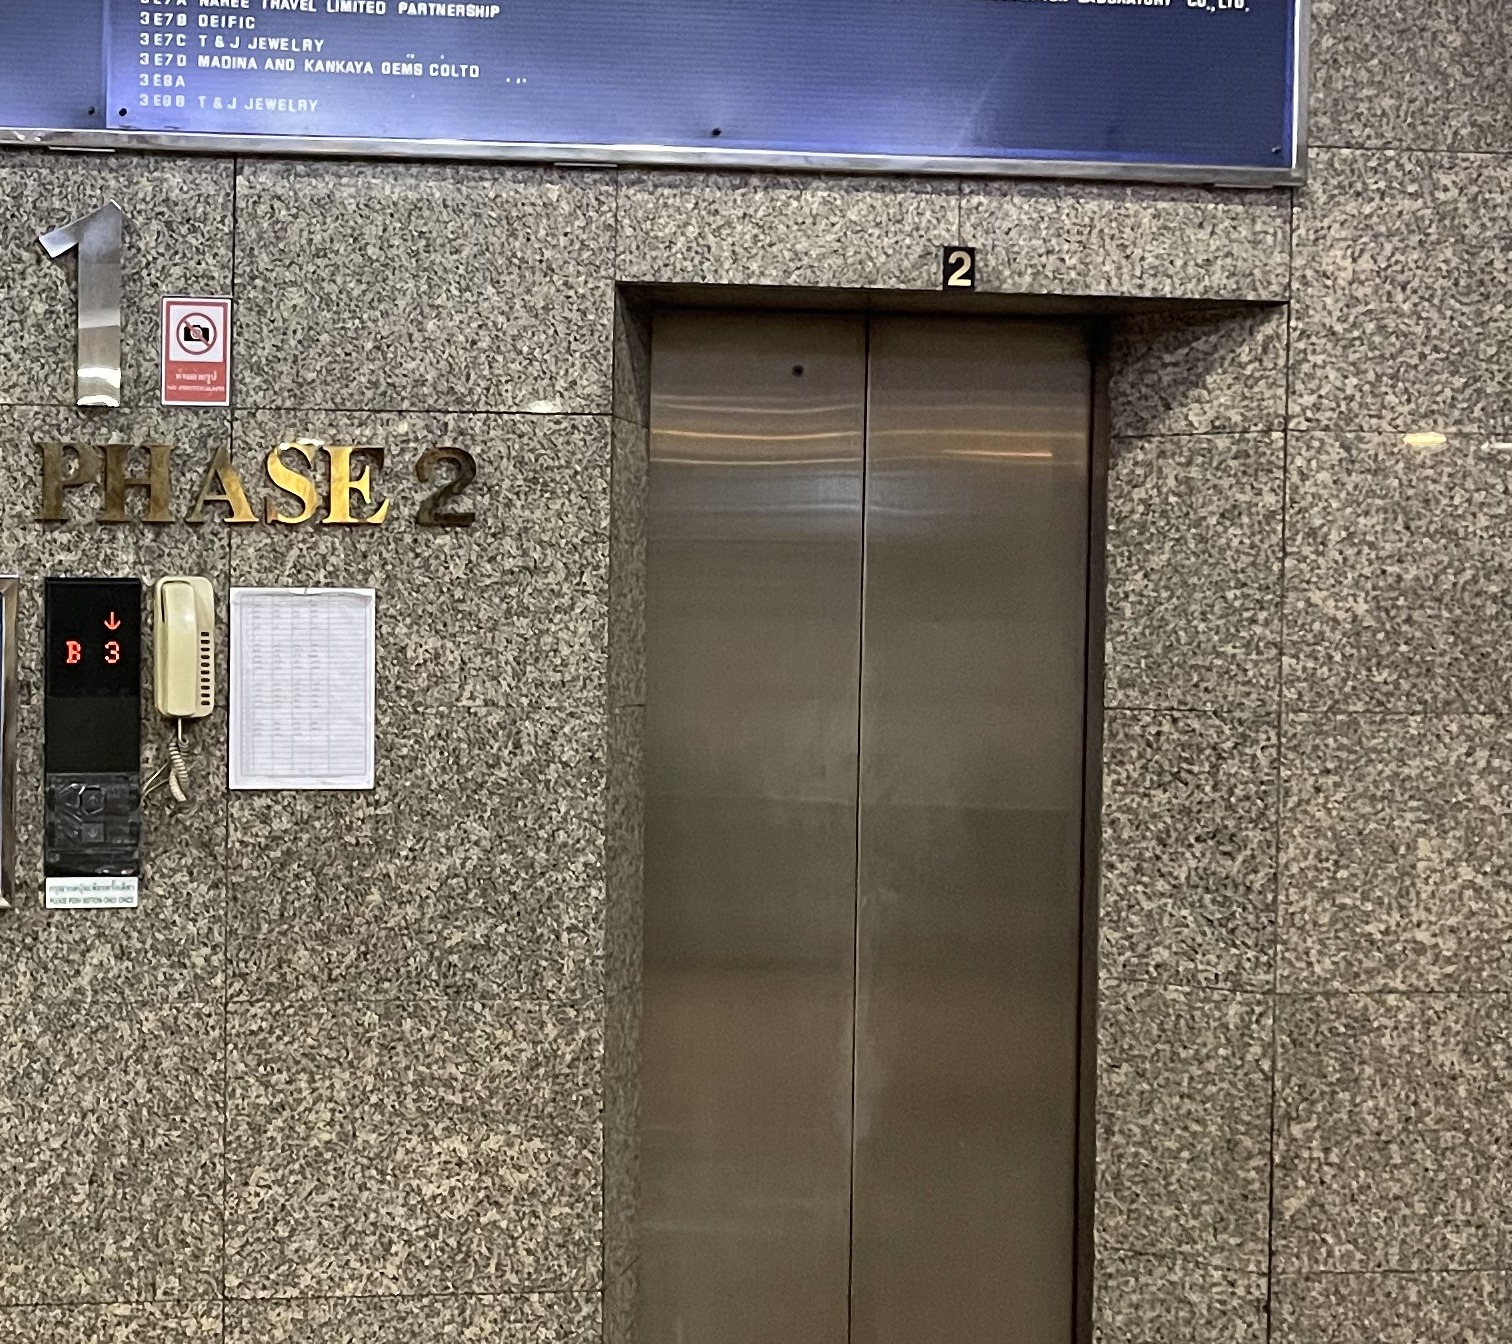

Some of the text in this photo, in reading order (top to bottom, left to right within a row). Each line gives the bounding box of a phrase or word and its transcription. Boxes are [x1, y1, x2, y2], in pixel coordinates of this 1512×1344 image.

[327, 0, 386, 14] LIMITED
[398, 1, 500, 18] PARTNERSHIP
[198, 14, 255, 29] DEIFIC
[140, 33, 324, 52] 3E7C T & J JEWELRY
[198, 55, 422, 76] MADINA AND KANKAYA GEMS
[947, 250, 972, 287] 2
[38, 199, 122, 407] 1
[34, 440, 390, 524] PHASE
[414, 446, 477, 527] 2
[66, 641, 120, 664] B 3
